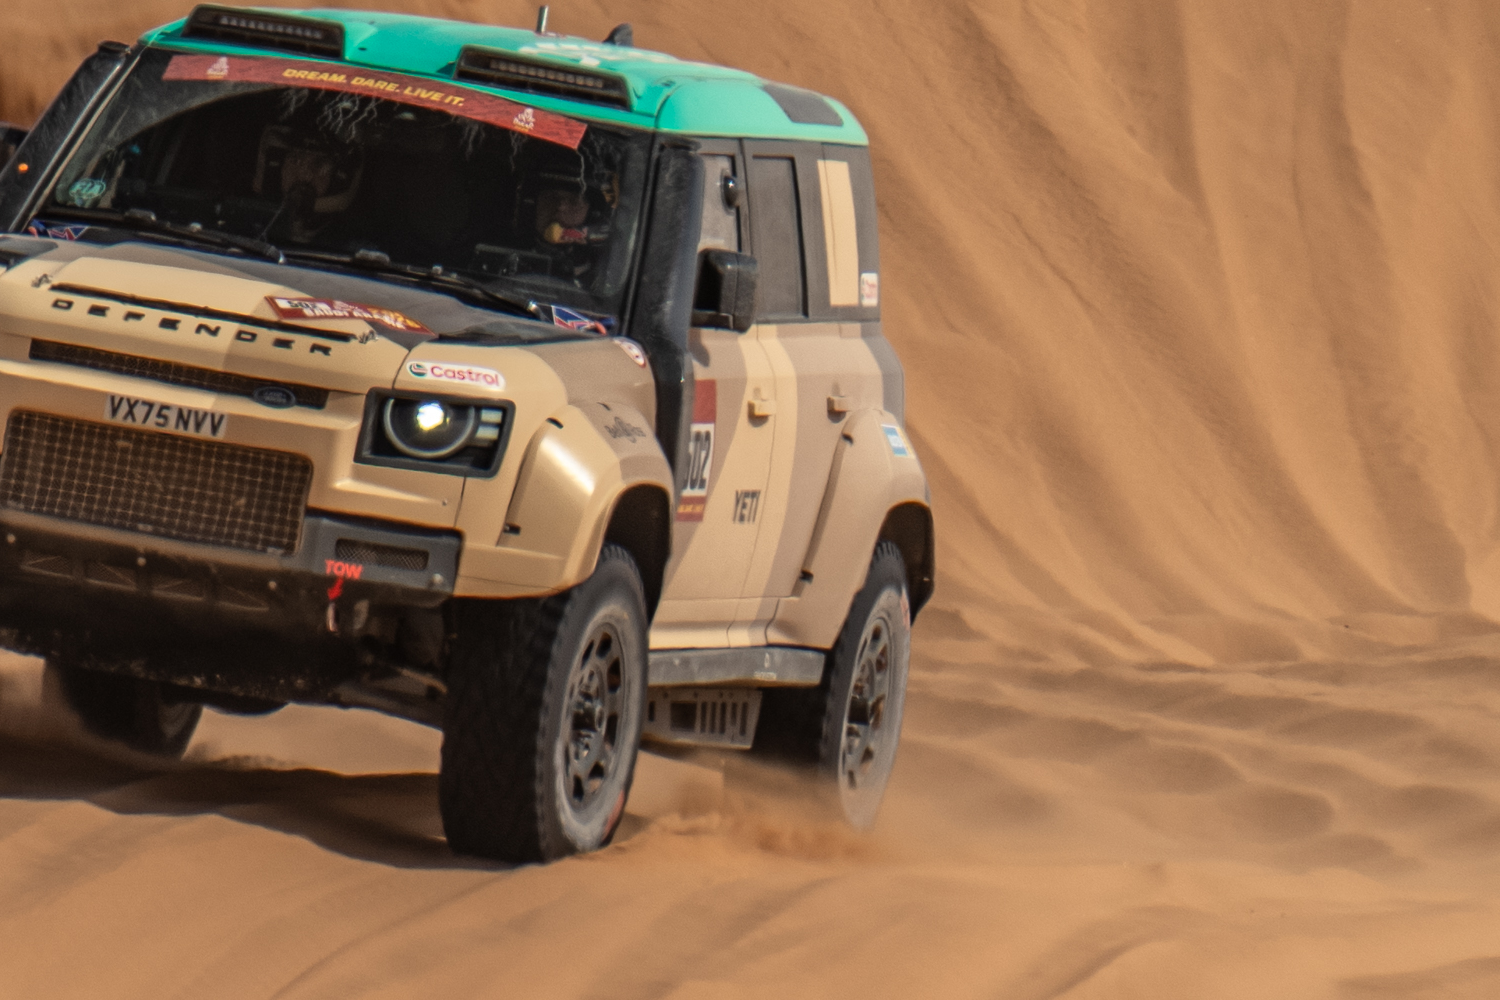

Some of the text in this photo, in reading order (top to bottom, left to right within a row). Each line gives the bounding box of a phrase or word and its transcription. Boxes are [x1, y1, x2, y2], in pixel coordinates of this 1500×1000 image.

[282, 68, 465, 107] DREAM. DARE. LIVE IT.
[69, 180, 105, 198] FIA
[52, 297, 332, 357] DEFENDER
[430, 365, 500, 387] Castrol
[108, 394, 225, 437] VX75 NVV
[732, 489, 761, 524] YETI
[325, 559, 364, 580] TOW
